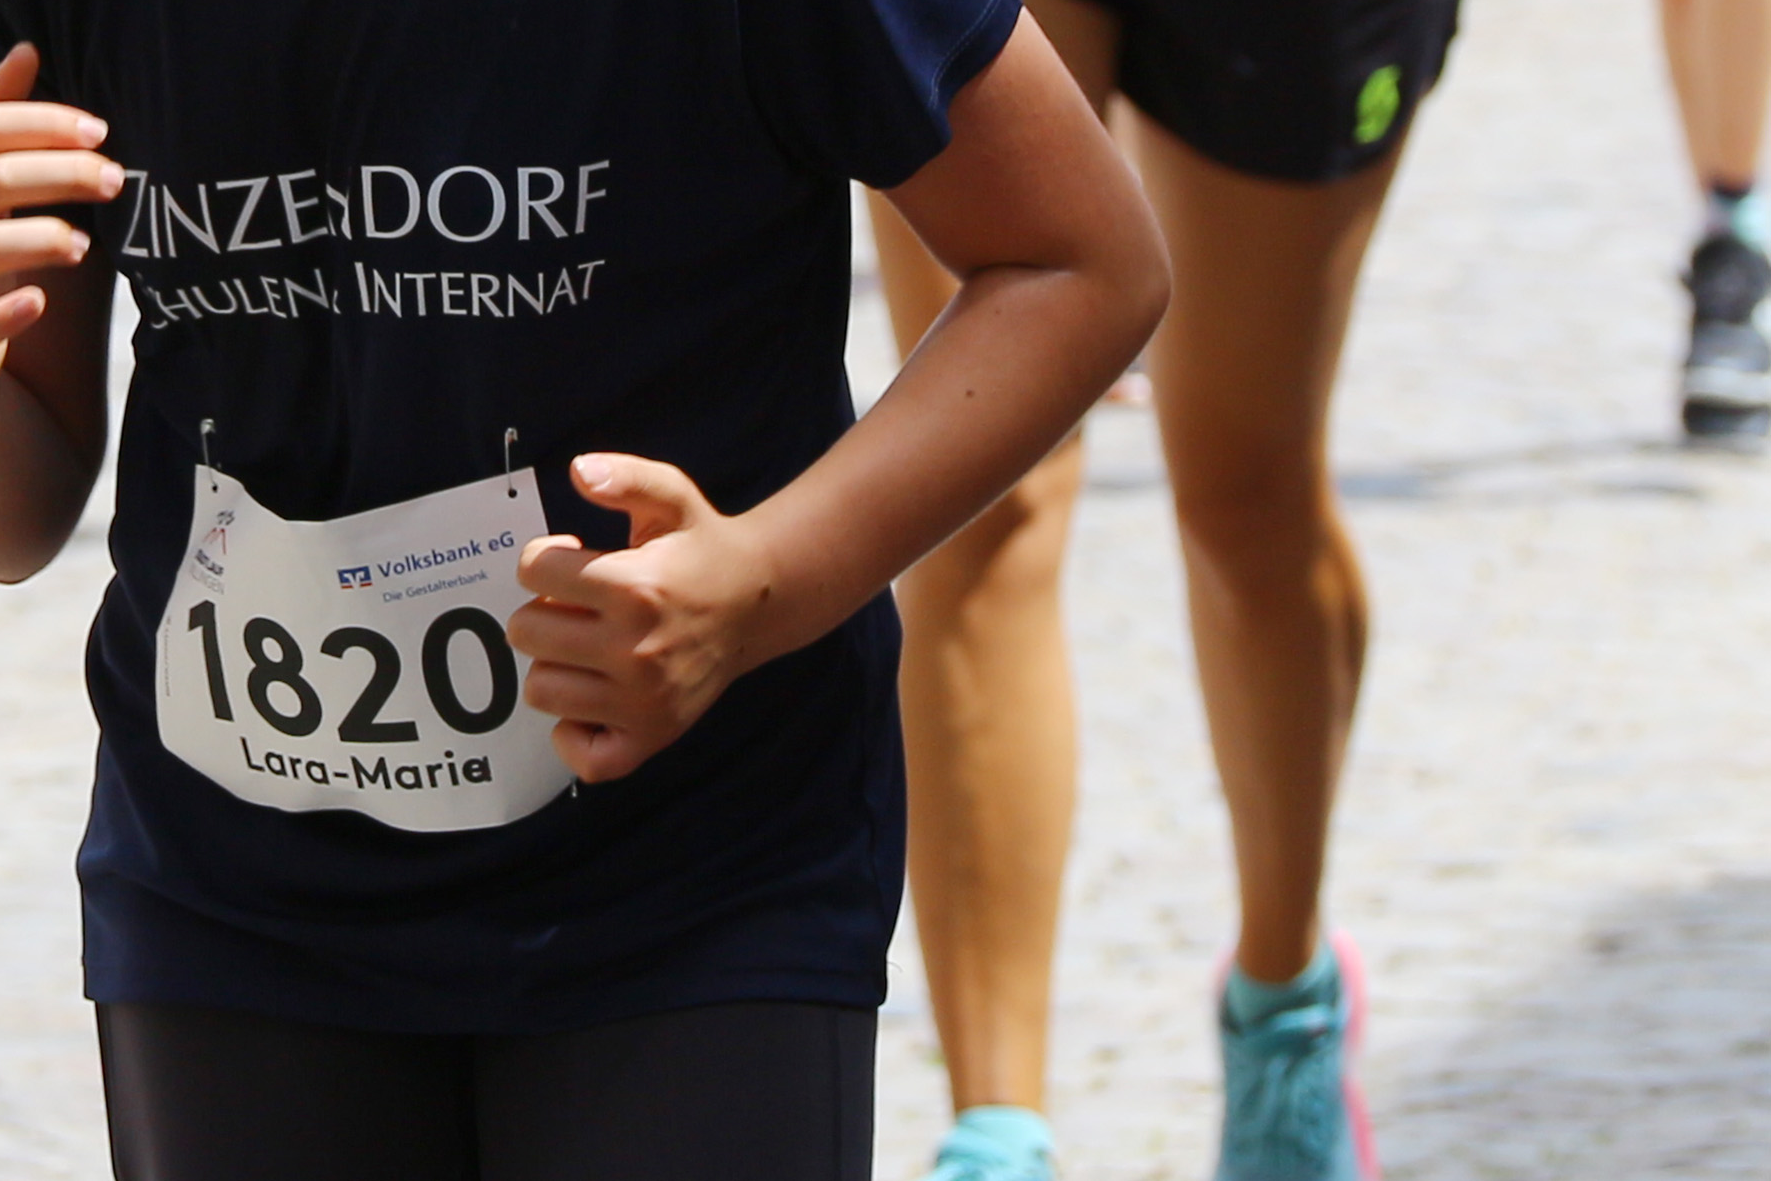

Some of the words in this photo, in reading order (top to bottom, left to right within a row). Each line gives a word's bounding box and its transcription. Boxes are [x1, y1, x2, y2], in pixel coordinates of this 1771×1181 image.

[134, 268, 330, 330] HULEN
[354, 260, 605, 318] INTERNAT
[377, 540, 482, 579] Volksbank
[488, 531, 515, 552] eG
[382, 591, 404, 603] Die
[405, 570, 489, 597] Gestalterbank
[188, 600, 519, 743] 1820
